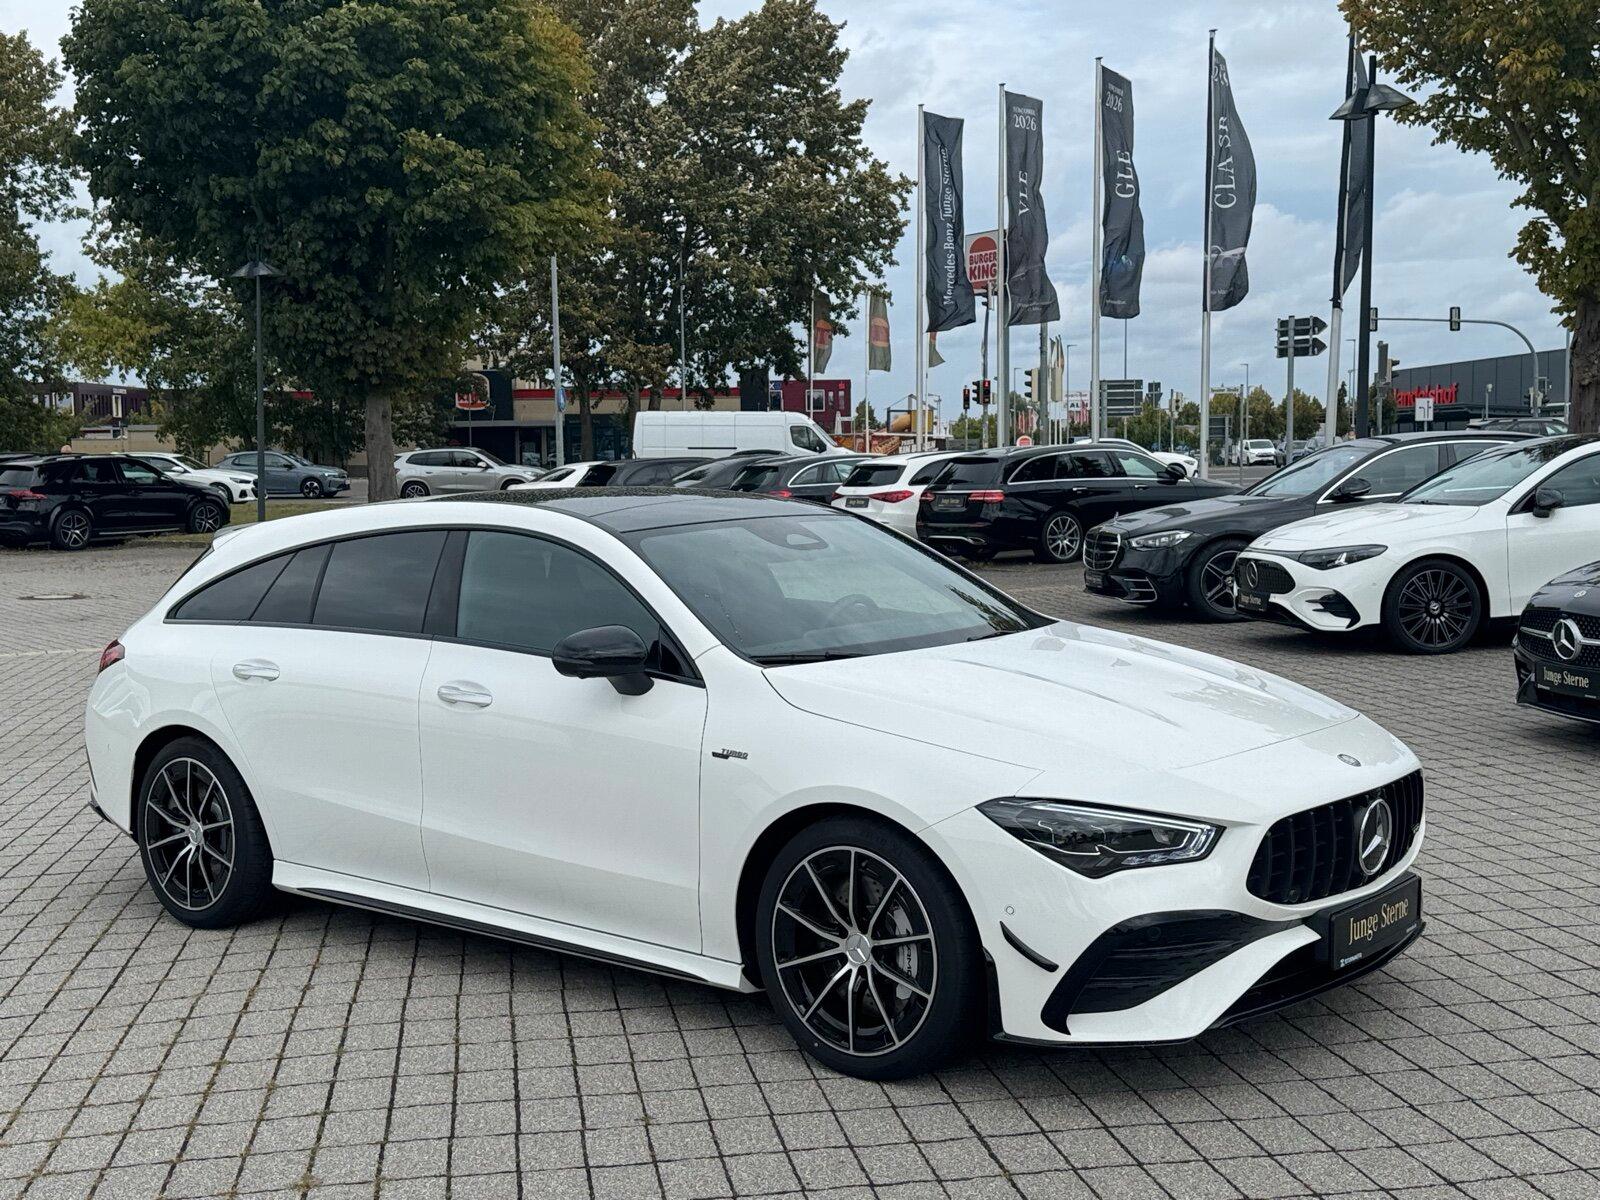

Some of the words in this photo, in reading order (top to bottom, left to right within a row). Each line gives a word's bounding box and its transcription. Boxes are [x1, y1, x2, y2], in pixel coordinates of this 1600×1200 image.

[1105, 91, 1123, 113] 2026
[1012, 113, 1037, 131] 2026
[1115, 150, 1136, 199] GLE
[943, 187, 953, 219] Junge
[1018, 170, 1030, 216] VLE
[942, 222, 956, 306] Mercedes-Benz
[969, 251, 997, 265] BURGER
[969, 262, 997, 281] KING
[1543, 666, 1562, 686] Junge
[1562, 670, 1589, 688] Sterne
[1348, 913, 1379, 945] Junge
[1381, 898, 1409, 928] Sterne
